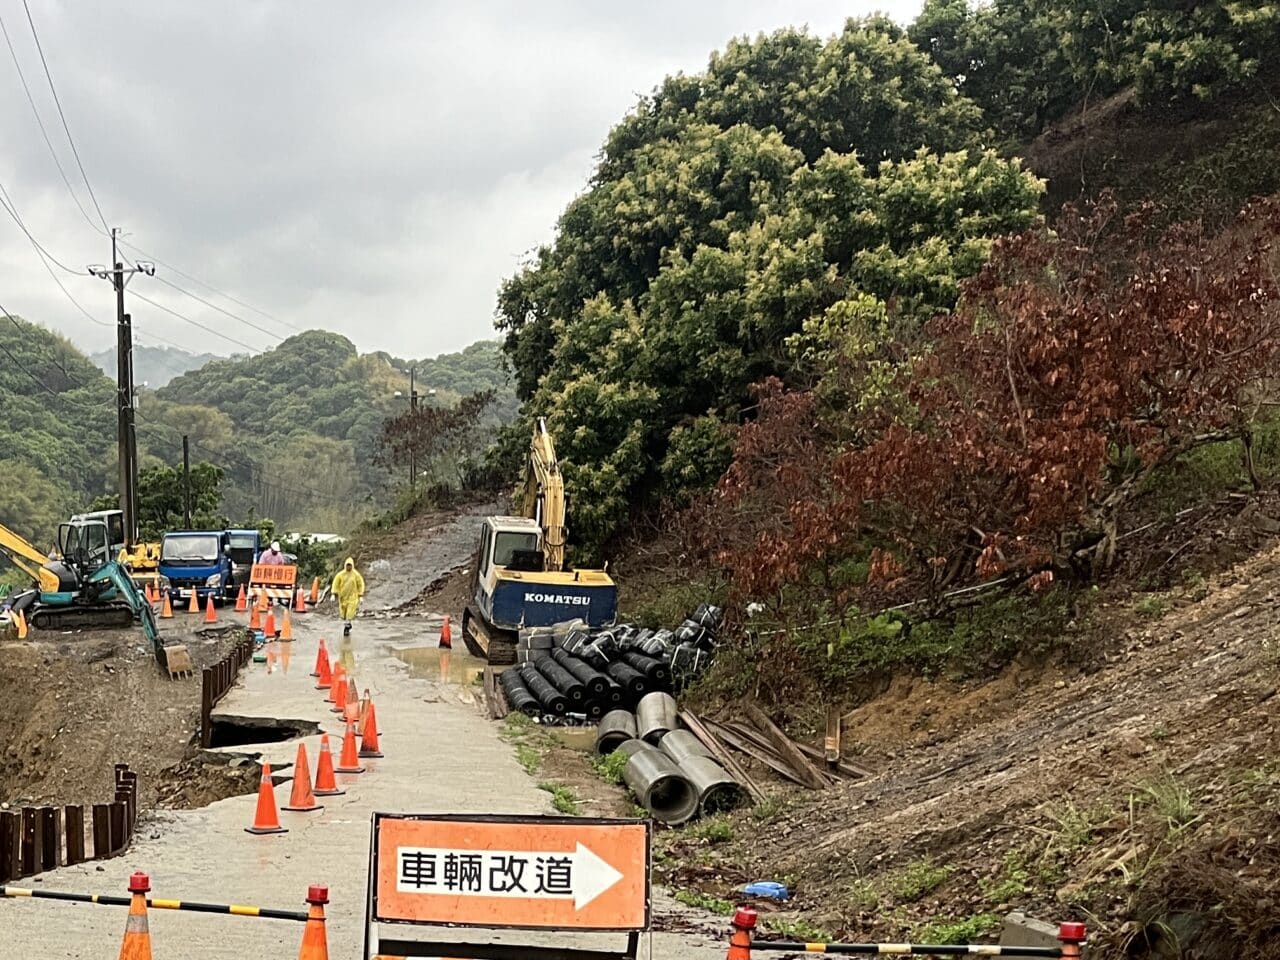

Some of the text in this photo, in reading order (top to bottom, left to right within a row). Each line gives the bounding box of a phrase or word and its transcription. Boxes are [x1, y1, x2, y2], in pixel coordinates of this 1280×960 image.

[524, 592, 591, 606] KOMATSU
[400, 851, 573, 895] 車輛改道
